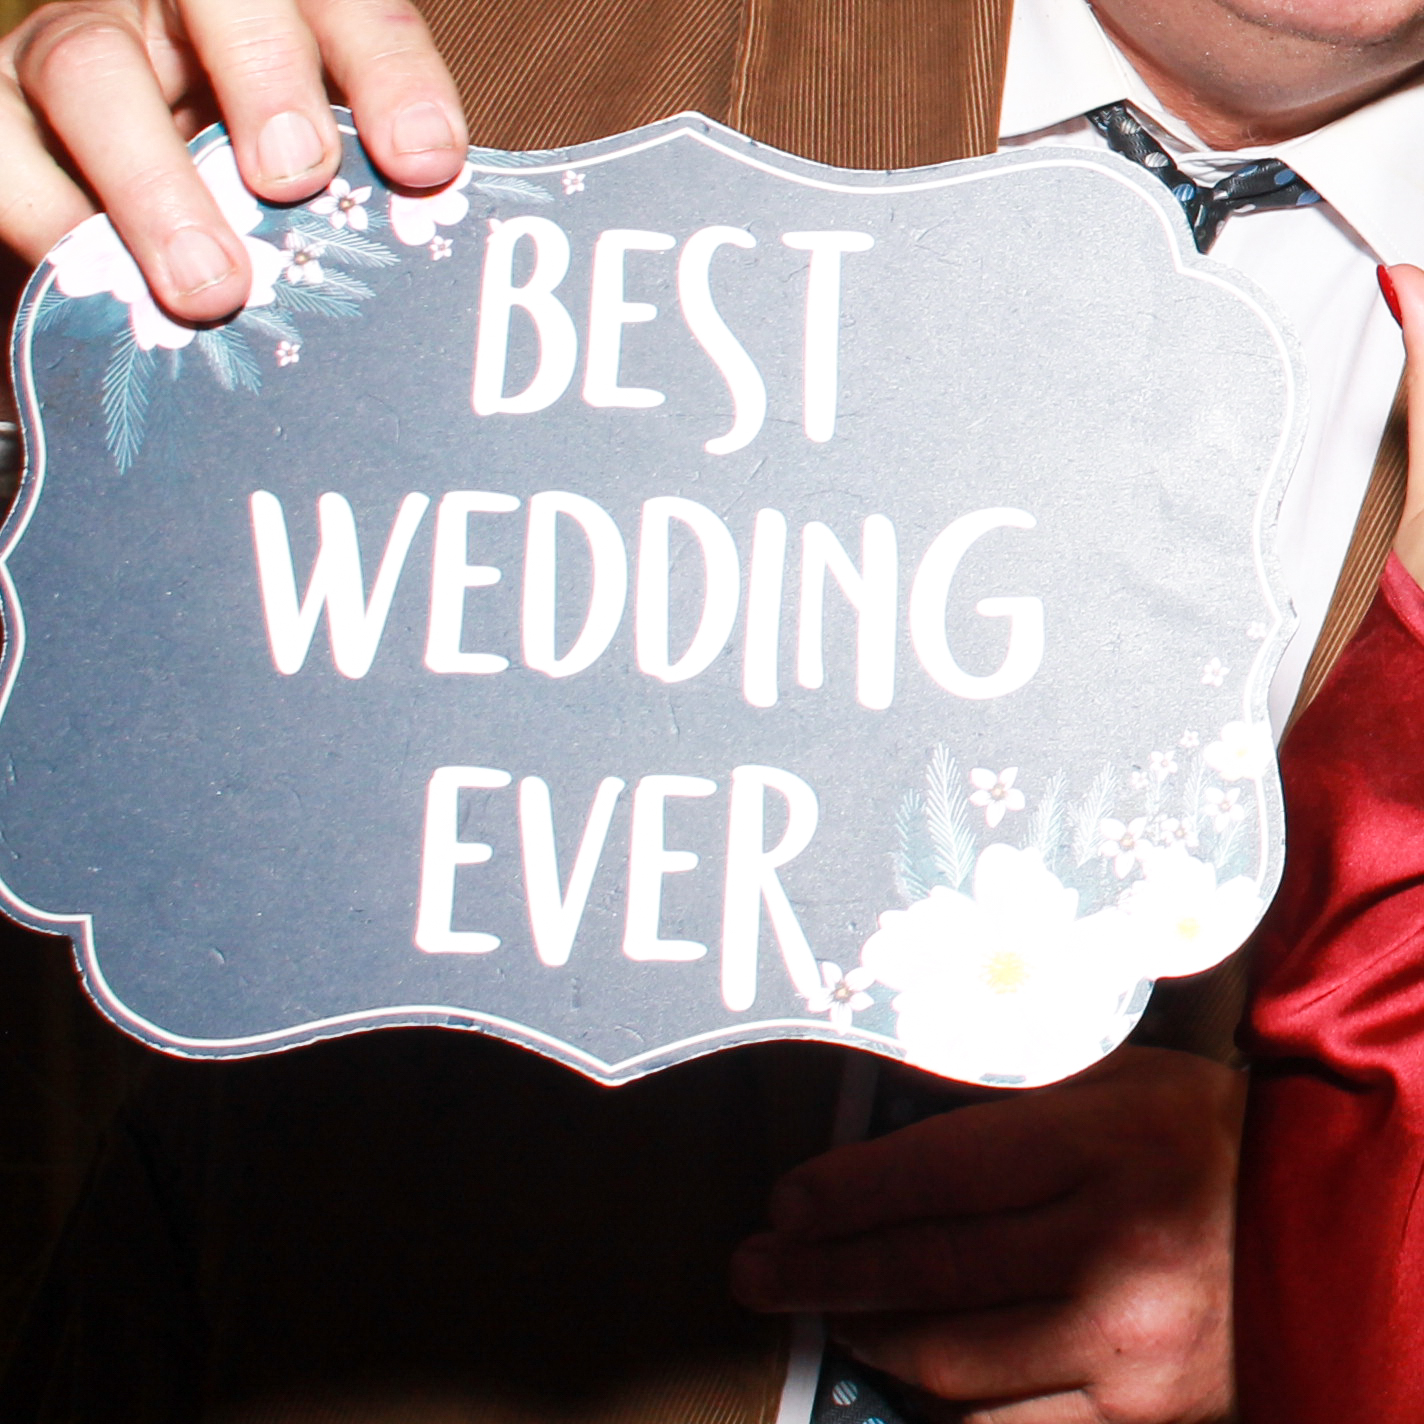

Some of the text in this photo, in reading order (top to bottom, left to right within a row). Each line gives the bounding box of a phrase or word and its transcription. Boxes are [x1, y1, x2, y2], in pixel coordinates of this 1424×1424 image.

[469, 215, 875, 455] BEST
[249, 490, 1045, 710] WEDDING
[414, 765, 824, 1012] EVER
